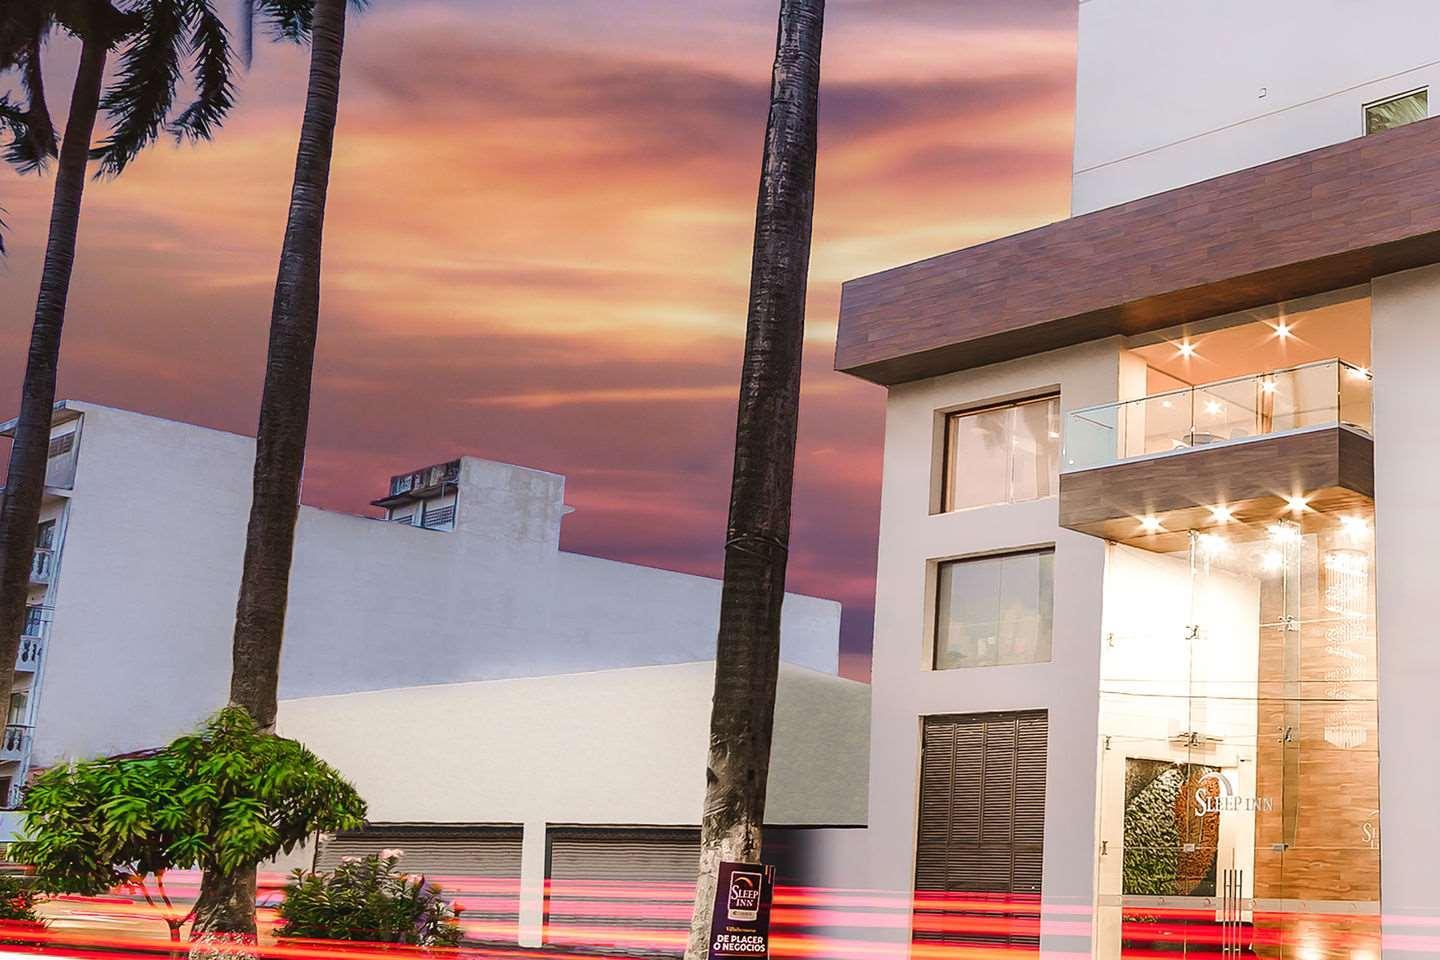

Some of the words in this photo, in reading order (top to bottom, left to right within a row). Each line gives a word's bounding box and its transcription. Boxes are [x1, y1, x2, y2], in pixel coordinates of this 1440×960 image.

[1195, 787, 1242, 817] SLEEP
[731, 884, 759, 900] SLEEP
[736, 898, 753, 907] INN
[716, 934, 730, 943] DE
[731, 935, 764, 944] PLACER
[713, 942, 721, 951] O
[722, 943, 766, 952] NEGOCIOS
